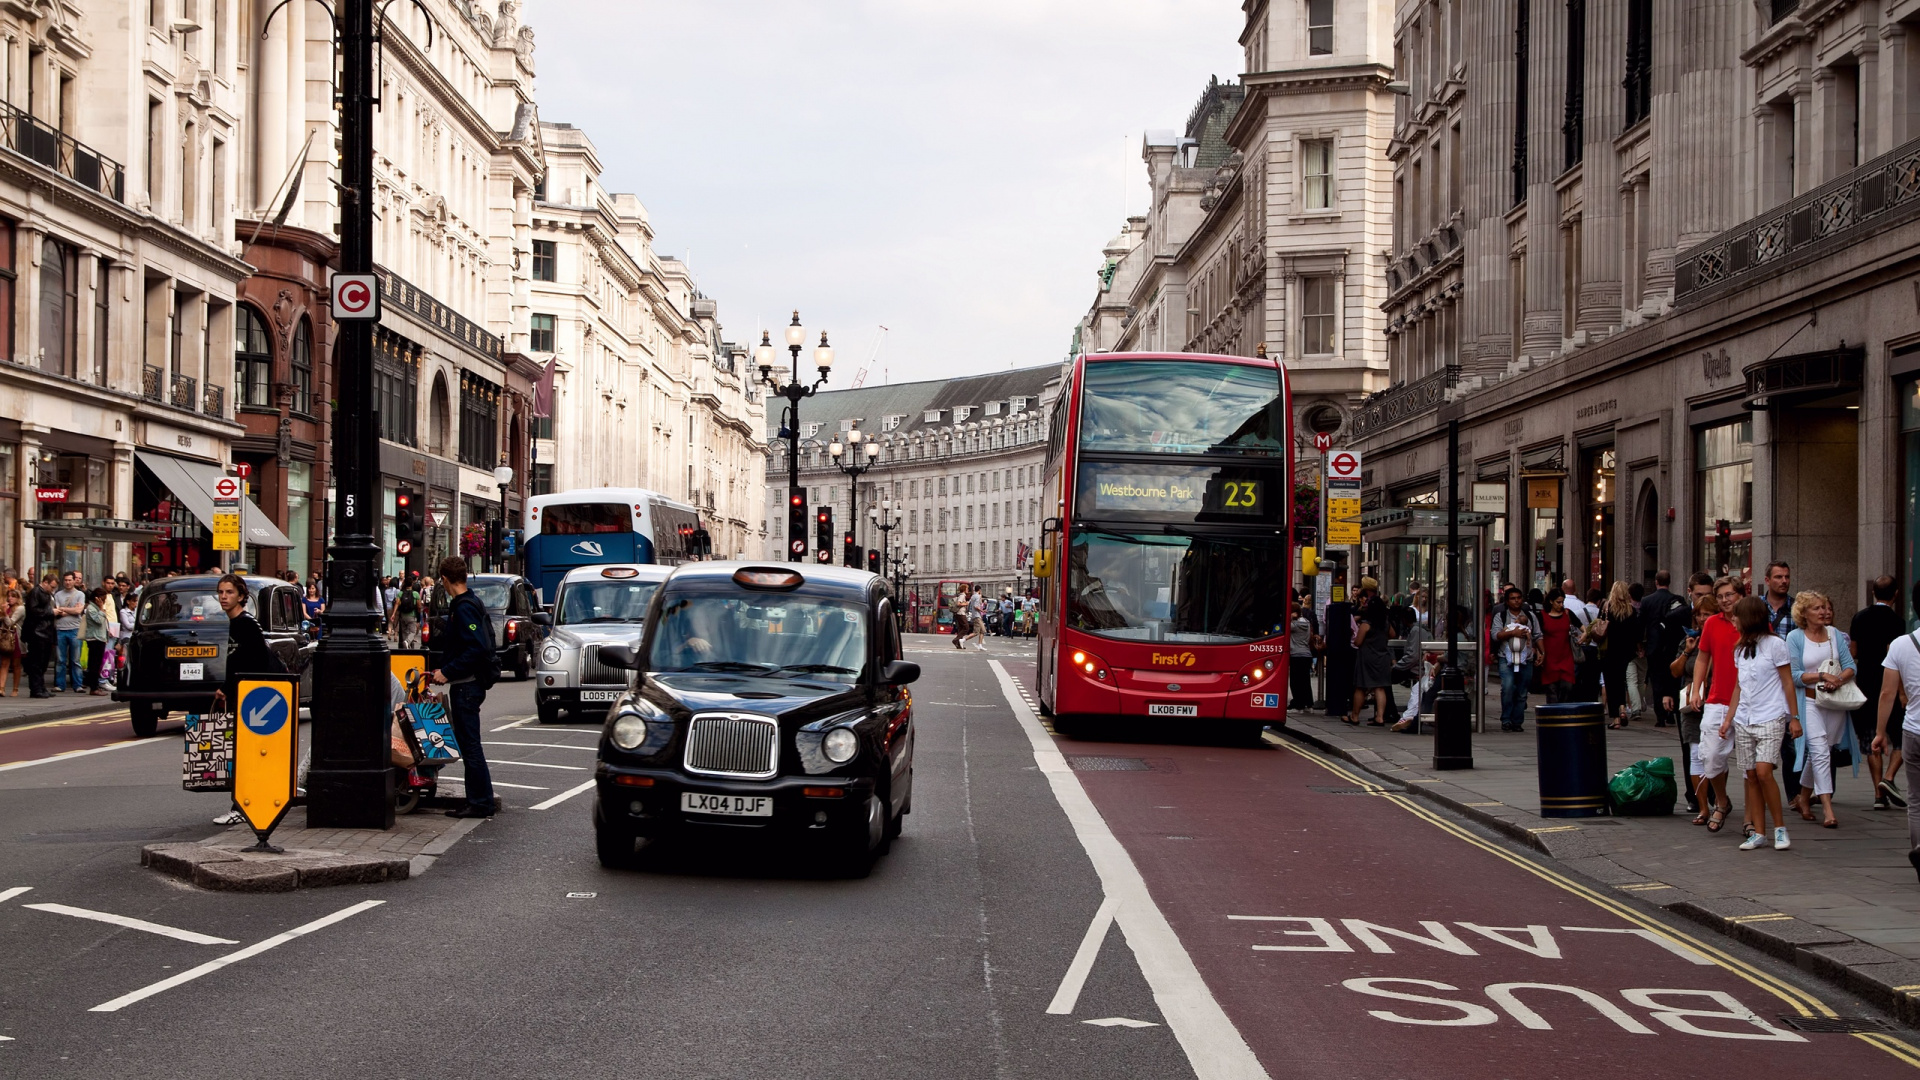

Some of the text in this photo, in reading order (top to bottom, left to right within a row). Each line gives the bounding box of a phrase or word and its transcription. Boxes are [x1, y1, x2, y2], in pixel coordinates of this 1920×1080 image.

[1317, 435, 1330, 448] M
[239, 464, 249, 476] T
[1099, 481, 1257, 507] Westbourne Park 23
[168, 647, 216, 657] M883 UMT
[1249, 645, 1283, 653] DN33513
[1152, 652, 1179, 665] First
[1152, 705, 1194, 715] LK08 FMV
[688, 793, 766, 812] LX04 DJF
[1226, 914, 1717, 966] LANE
[1341, 976, 1811, 1043] BUS
